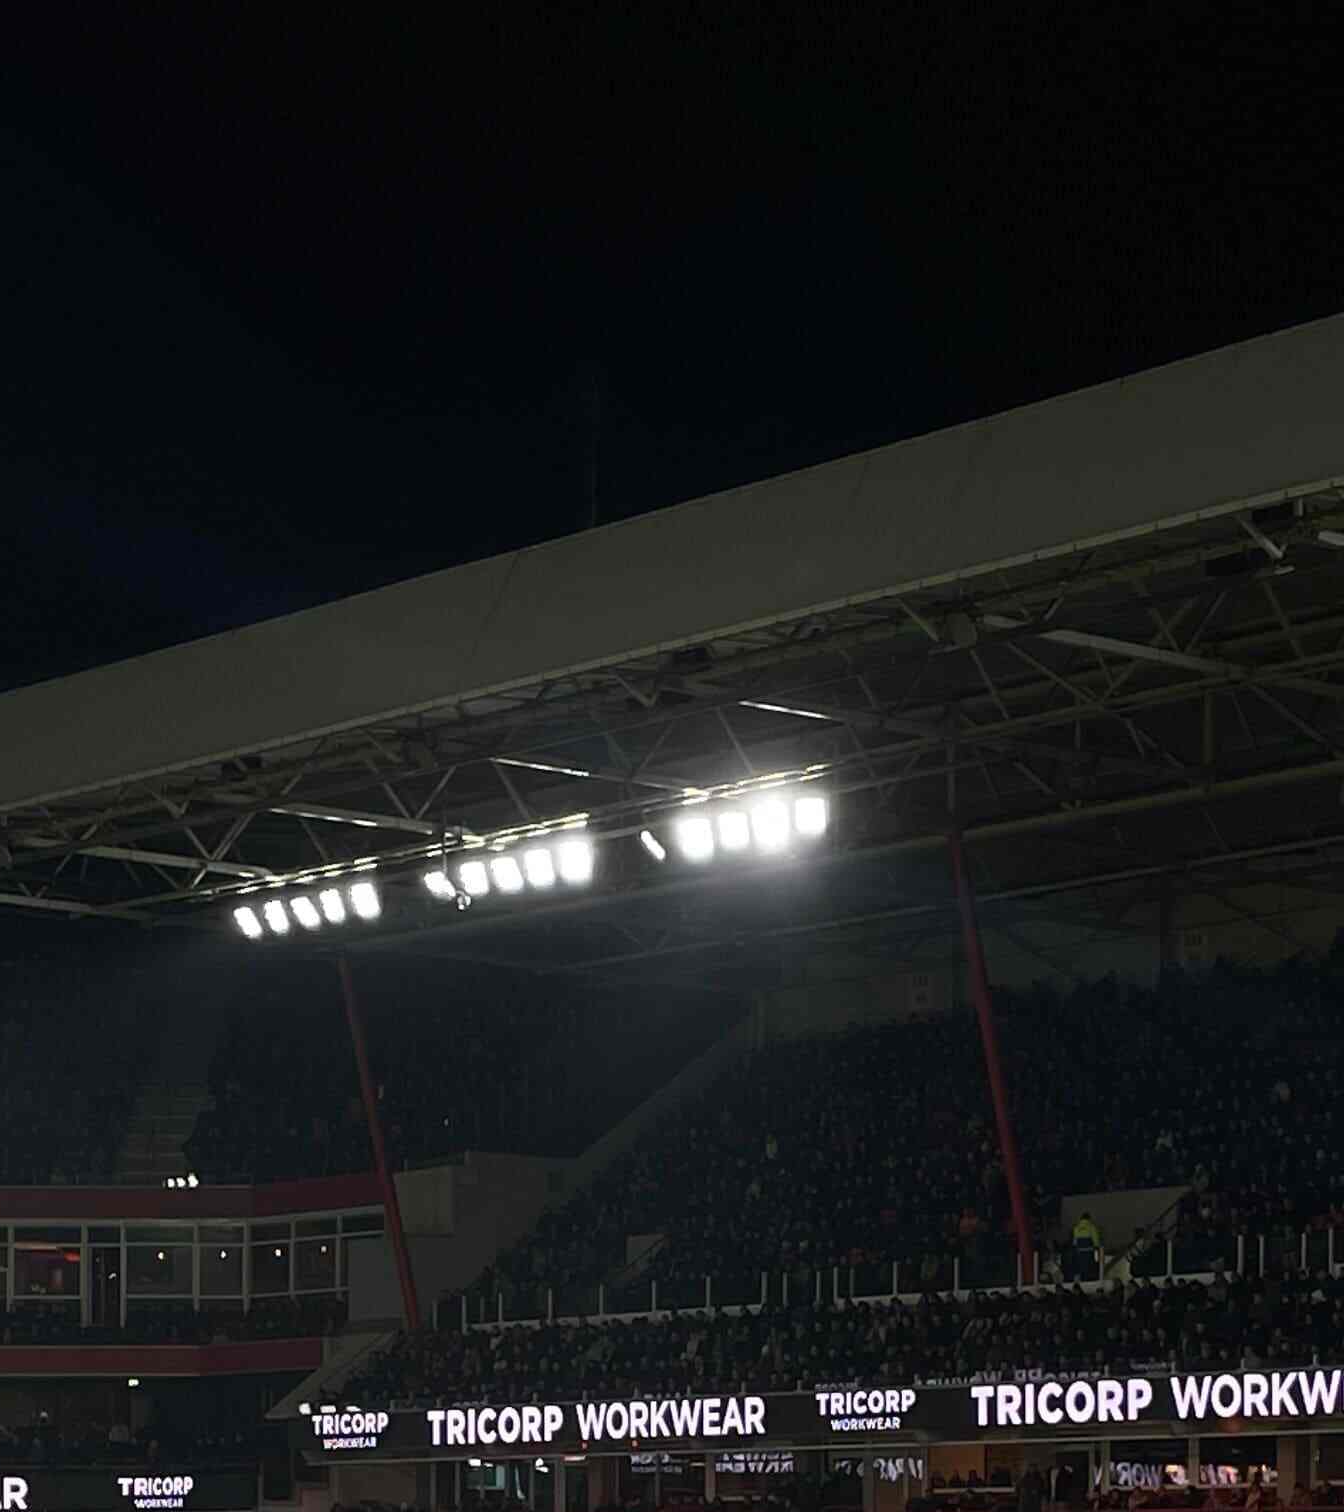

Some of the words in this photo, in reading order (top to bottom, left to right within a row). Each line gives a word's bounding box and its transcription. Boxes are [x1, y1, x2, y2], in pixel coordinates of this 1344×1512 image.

[815, 1388, 916, 1416] TRICORP
[970, 1377, 1153, 1426] TRICORP
[312, 1411, 389, 1436] TRICORP
[427, 1405, 564, 1446] TRICORP
[575, 1396, 766, 1440] WORKWEAR
[830, 1416, 901, 1431] WORKWEAR
[323, 1436, 377, 1450] WORKWEAR
[117, 1476, 194, 1496] TRICORP
[133, 1497, 184, 1509] WORKWEAR
